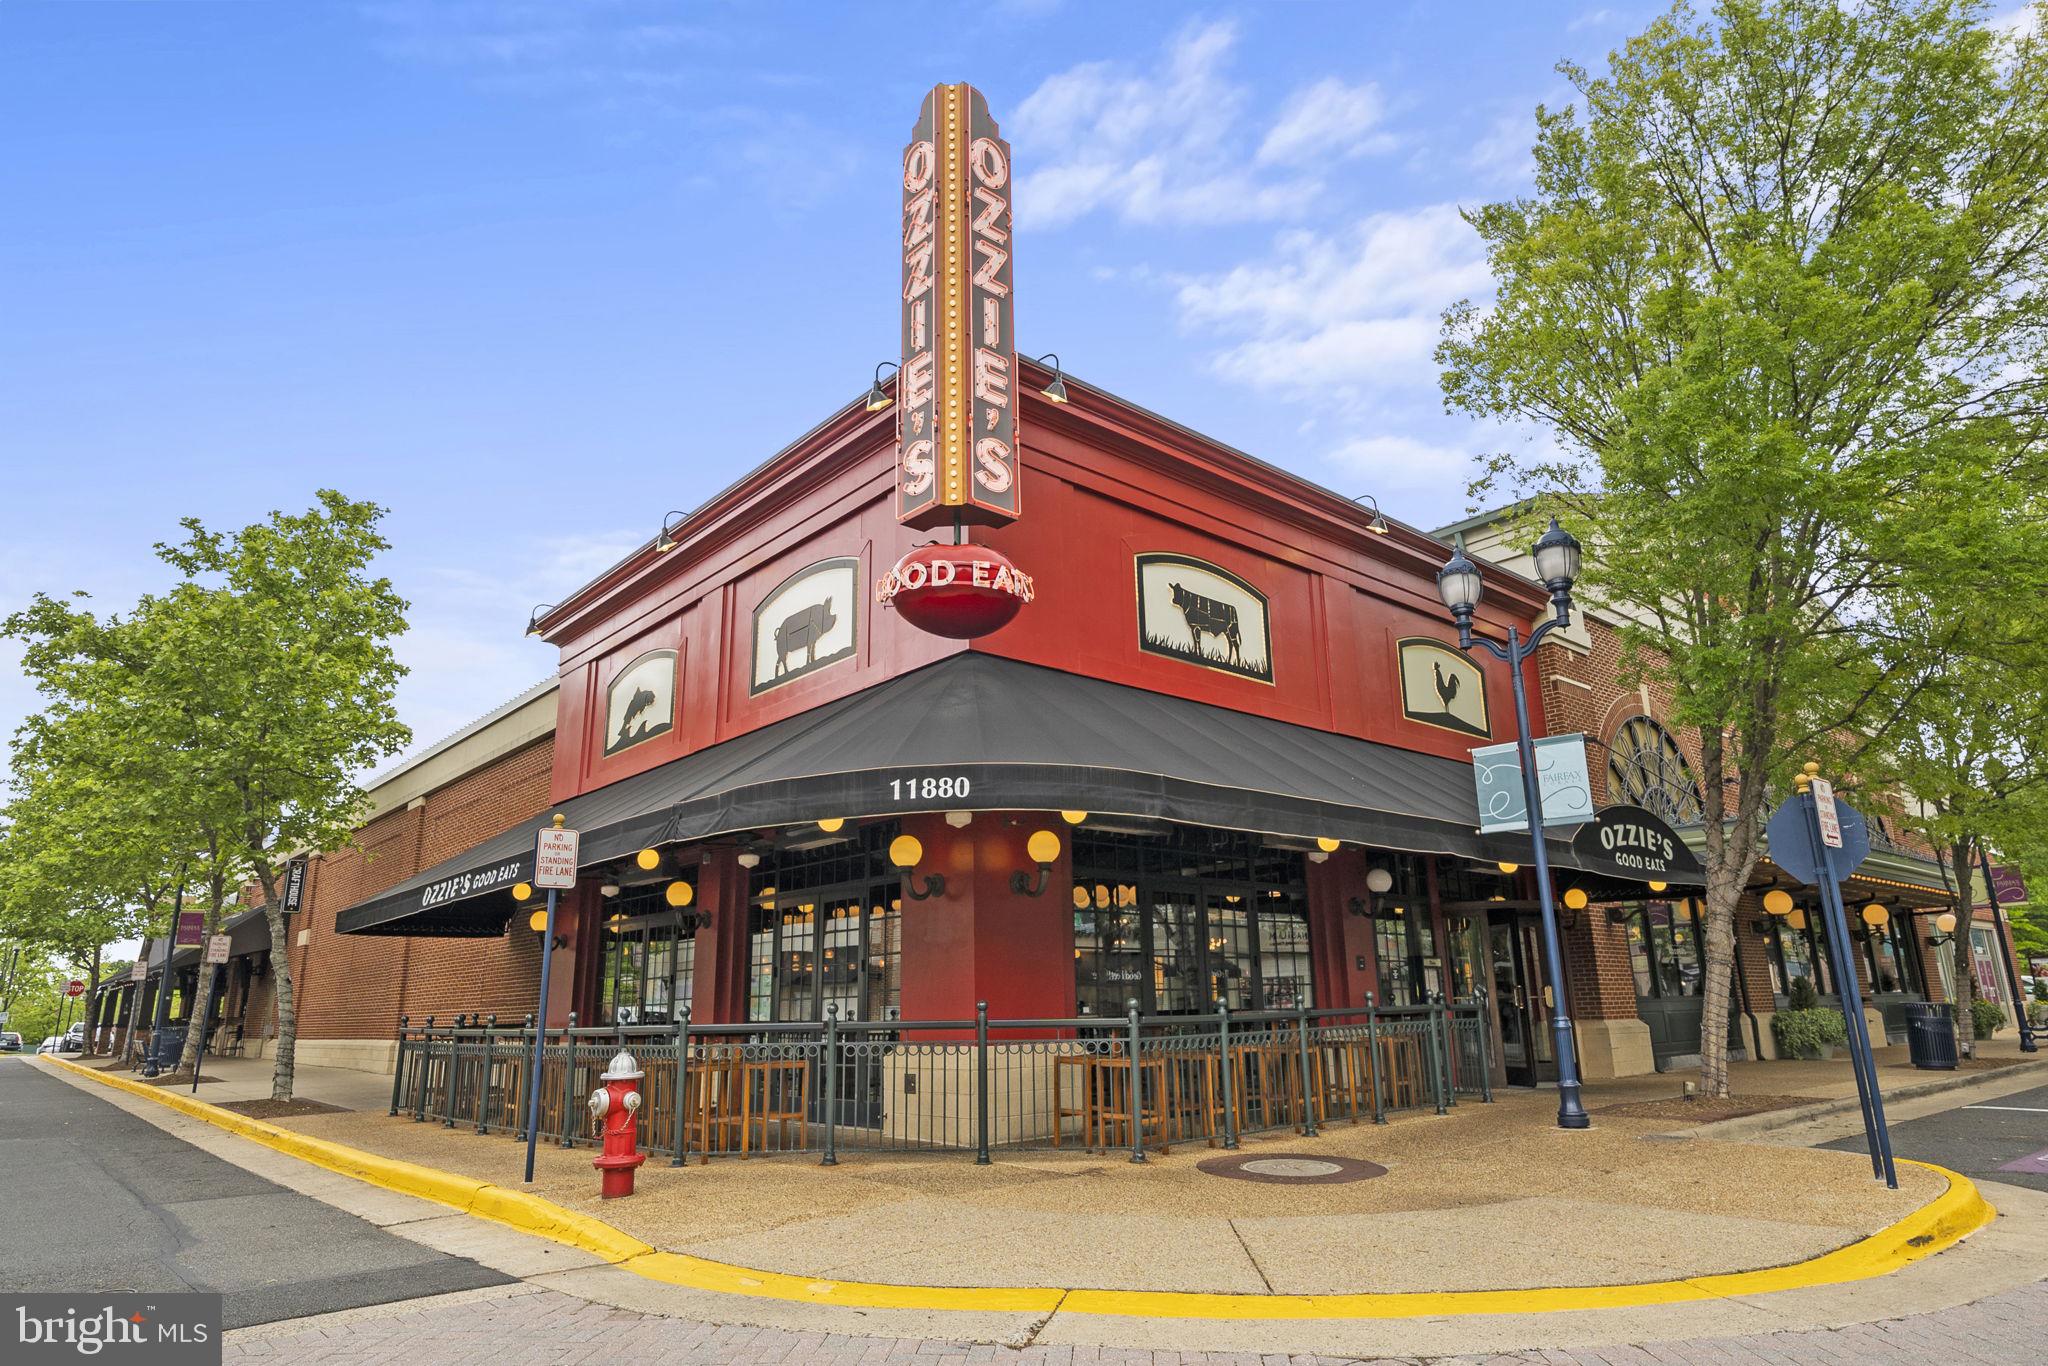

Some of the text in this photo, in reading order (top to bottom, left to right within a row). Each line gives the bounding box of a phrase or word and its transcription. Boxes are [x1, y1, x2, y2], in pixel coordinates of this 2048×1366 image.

[904, 141, 935, 496] OZZIE'S
[970, 137, 1013, 493] OZZIE'S
[1542, 770, 1581, 783] FAIRFAX
[889, 776, 970, 800] 11880
[543, 842, 573, 852] PARKING
[553, 833, 564, 841] NO
[1600, 824, 1674, 860] OZZIE'S
[539, 865, 573, 877] FIRE LANE
[540, 856, 574, 866] STANDING
[1615, 852, 1667, 872] GOOD EATS
[422, 862, 520, 906] OZZIE'S GOOD EATS
